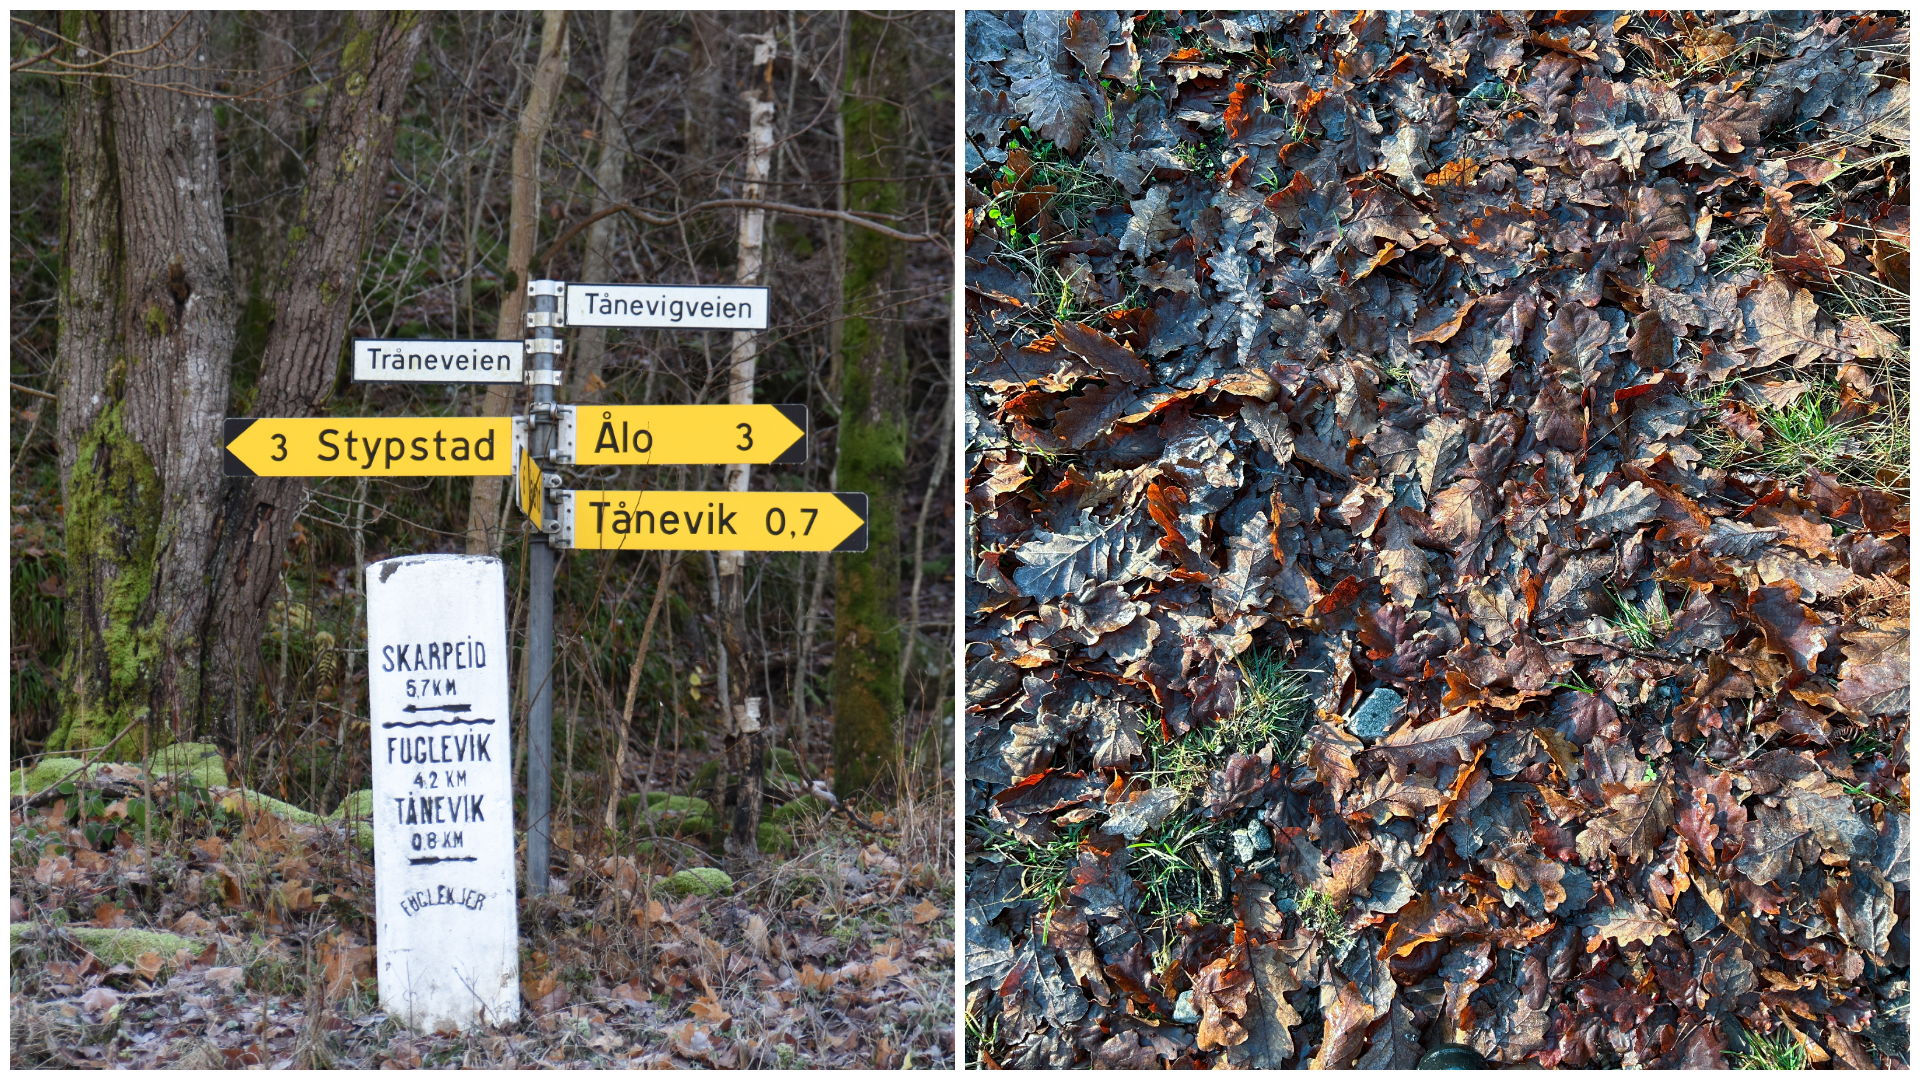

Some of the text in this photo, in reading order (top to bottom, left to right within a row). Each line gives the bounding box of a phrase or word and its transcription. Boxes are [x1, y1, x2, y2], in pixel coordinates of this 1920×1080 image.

[585, 292, 752, 322] Tånevigveien
[367, 347, 511, 371] Tråneveien
[270, 428, 495, 470] 3 Stypstad
[594, 410, 754, 454] Ålo 3
[588, 500, 819, 539] Tånevik 0,7
[387, 728, 492, 765] FUGLEVIK
[445, 769, 467, 788] KM
[394, 791, 485, 826] TÅNEVIK
[441, 830, 464, 849] KM
